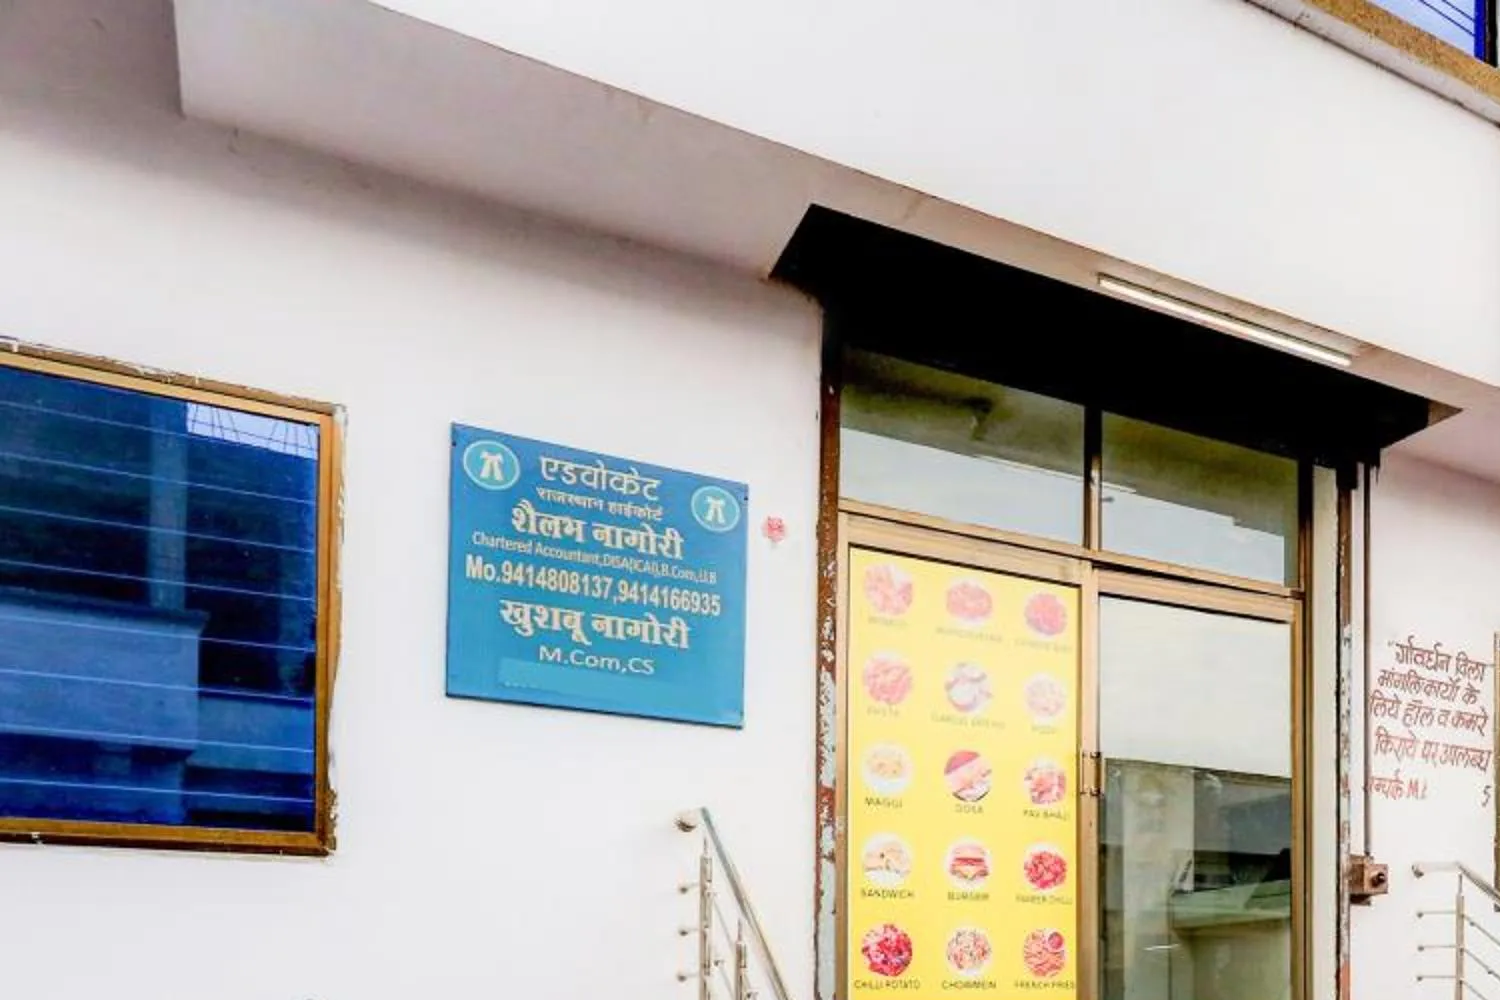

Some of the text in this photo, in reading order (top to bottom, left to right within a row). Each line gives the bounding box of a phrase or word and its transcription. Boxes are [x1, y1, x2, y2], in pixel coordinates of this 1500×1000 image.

[540, 456, 662, 501] एडवोकेट
[472, 531, 533, 555] Chartered
[592, 522, 684, 560] नागोरी
[591, 611, 690, 649] नागोरी
[538, 645, 656, 676] M.Com,CS
[861, 888, 915, 900] SANDWICH
